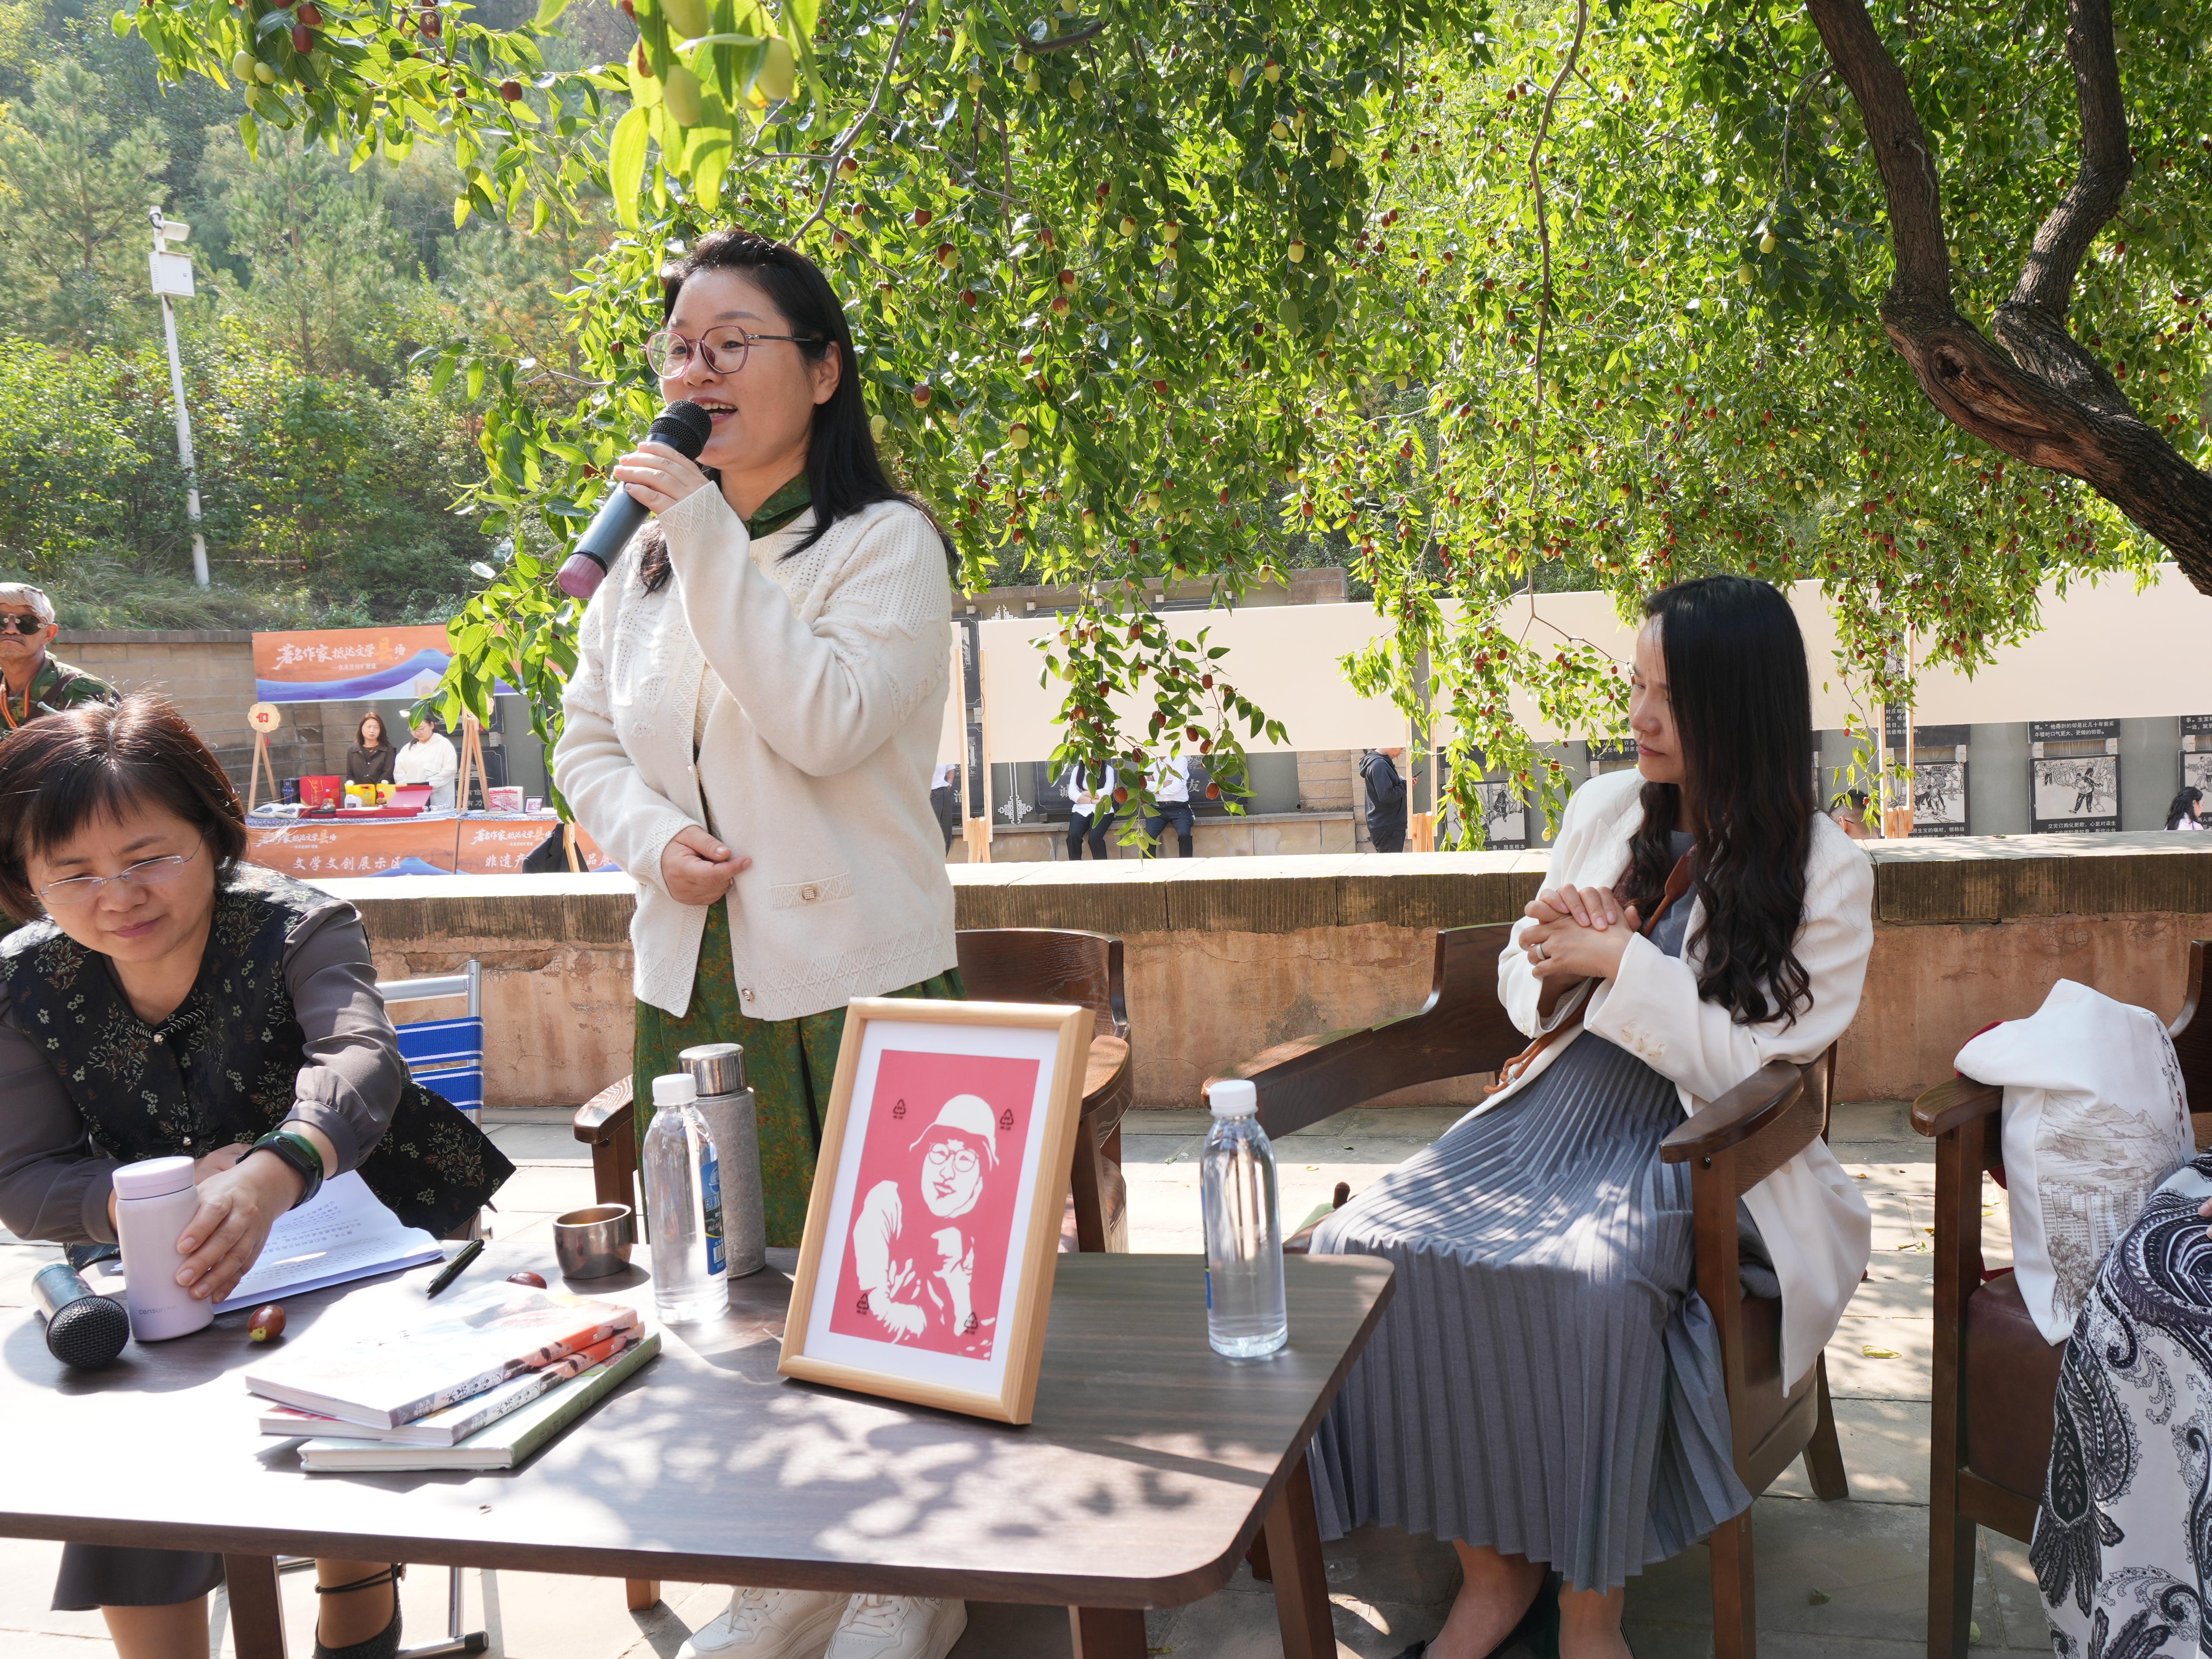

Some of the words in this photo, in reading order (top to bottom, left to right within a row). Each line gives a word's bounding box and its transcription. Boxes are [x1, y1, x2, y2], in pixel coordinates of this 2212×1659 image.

[256, 712, 268, 723] 们
[1188, 778, 1200, 793] 友
[292, 856, 402, 871] 文学文创展示区
